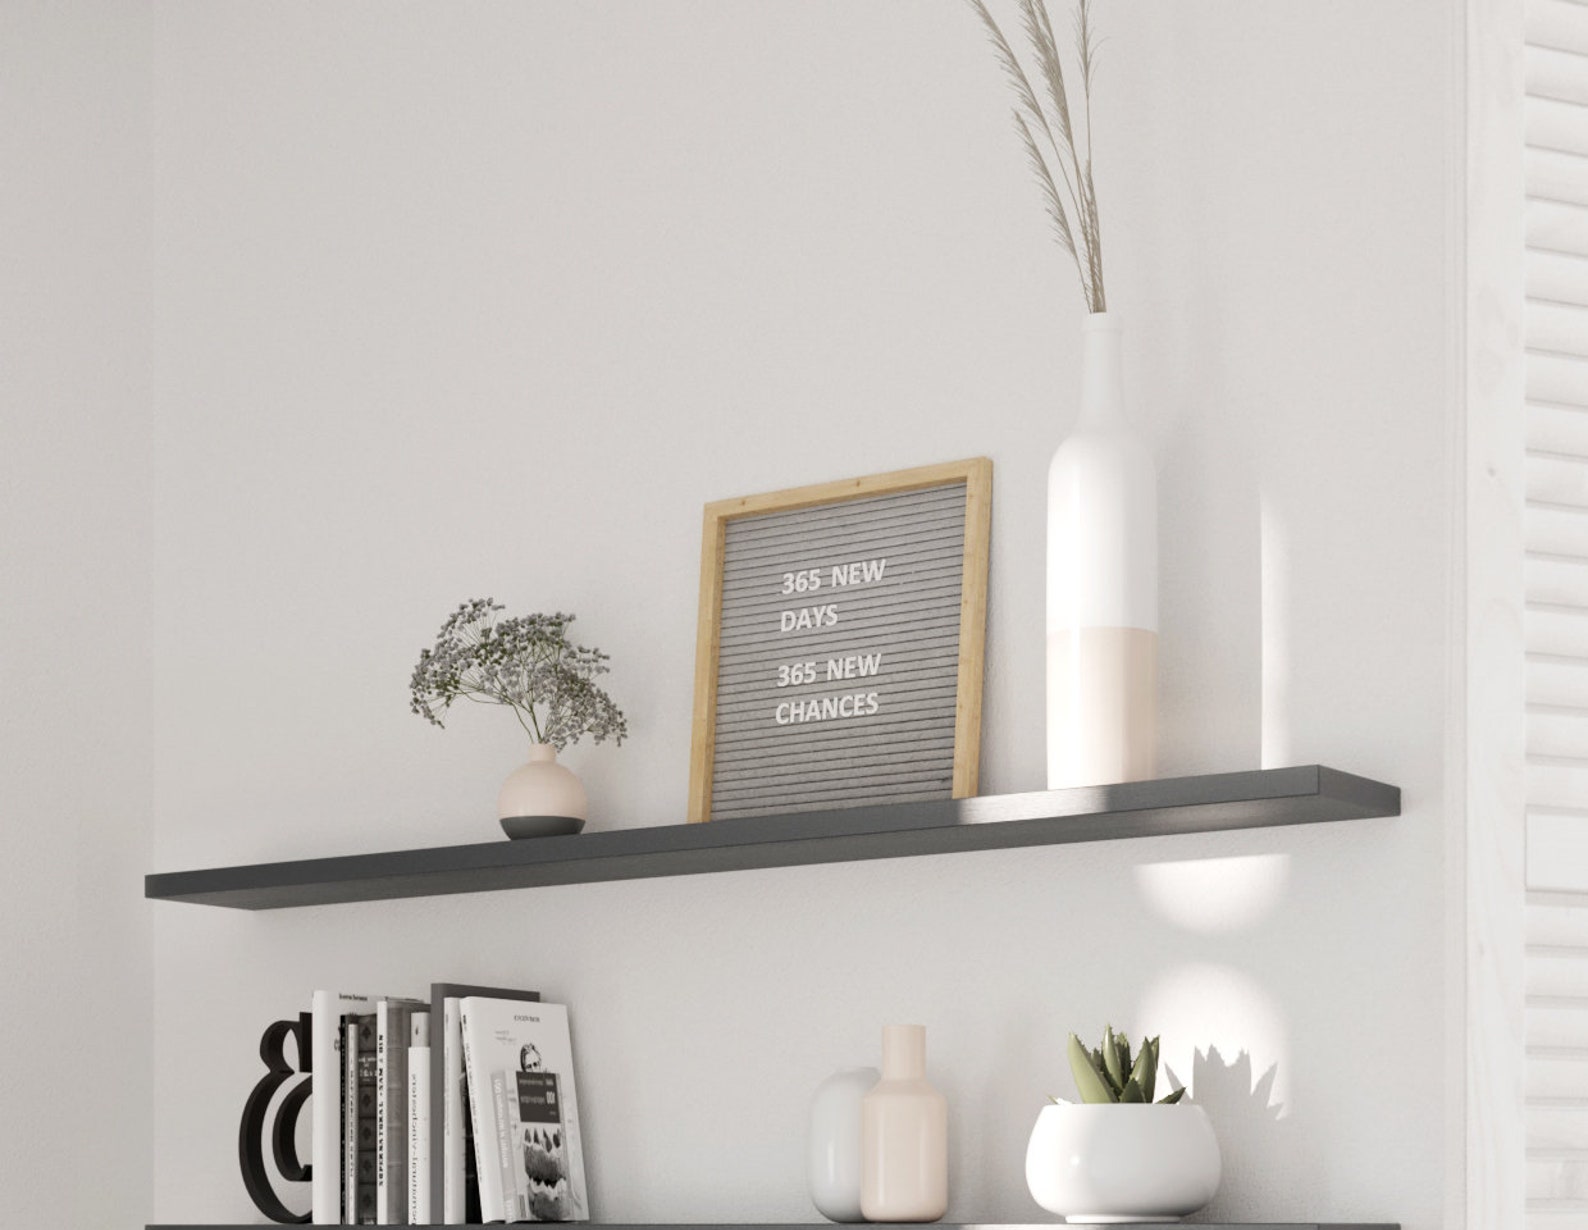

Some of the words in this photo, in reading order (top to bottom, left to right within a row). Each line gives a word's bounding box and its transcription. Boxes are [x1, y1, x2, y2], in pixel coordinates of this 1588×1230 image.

[782, 568, 821, 595] 365
[831, 559, 886, 587] NEW
[780, 604, 838, 632] DAYS
[777, 661, 817, 687] 365
[827, 653, 881, 680] NEW
[775, 692, 879, 725] CHANCES
